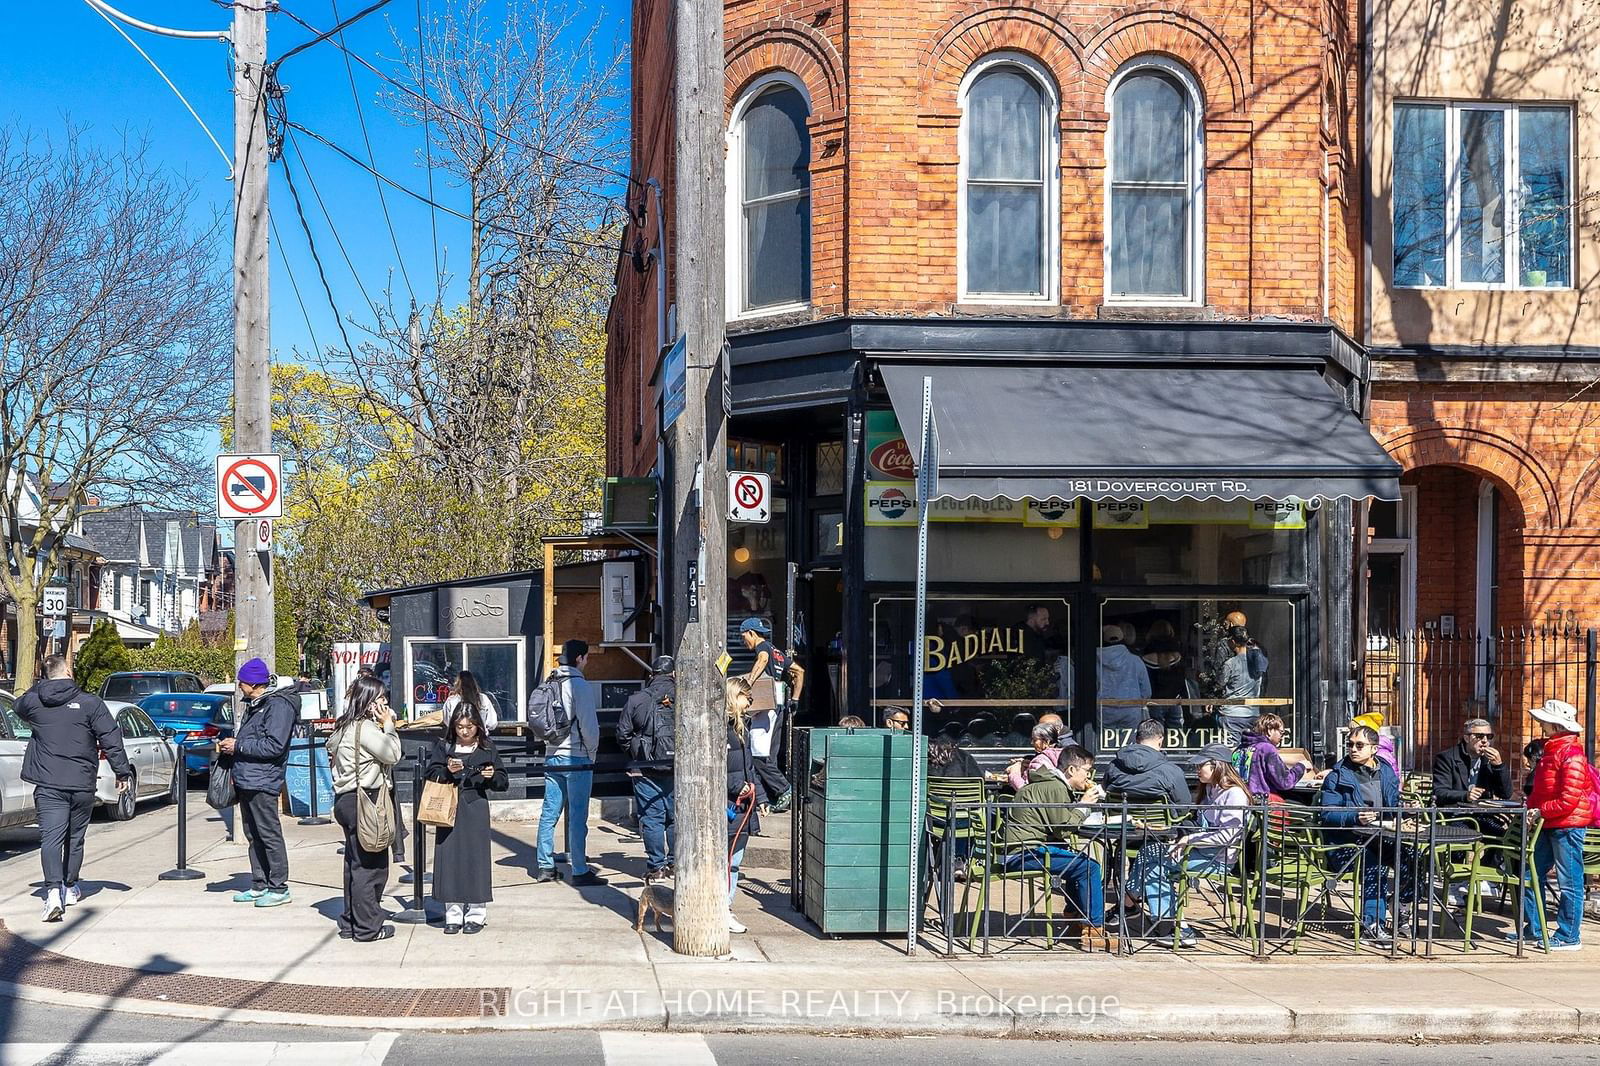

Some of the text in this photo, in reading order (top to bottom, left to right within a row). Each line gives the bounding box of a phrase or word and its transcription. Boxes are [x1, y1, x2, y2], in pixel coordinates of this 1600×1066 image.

[1068, 480, 1092, 492] 181
[869, 500, 917, 508] PEPSI
[1028, 501, 1075, 509] PEPSI
[1097, 502, 1144, 511] PEPSI
[1254, 502, 1300, 511] PEPSI
[46, 599, 64, 611] 30
[923, 627, 1025, 673] BADIALI
[333, 650, 357, 664] YO!
[1166, 728, 1192, 748] BY
